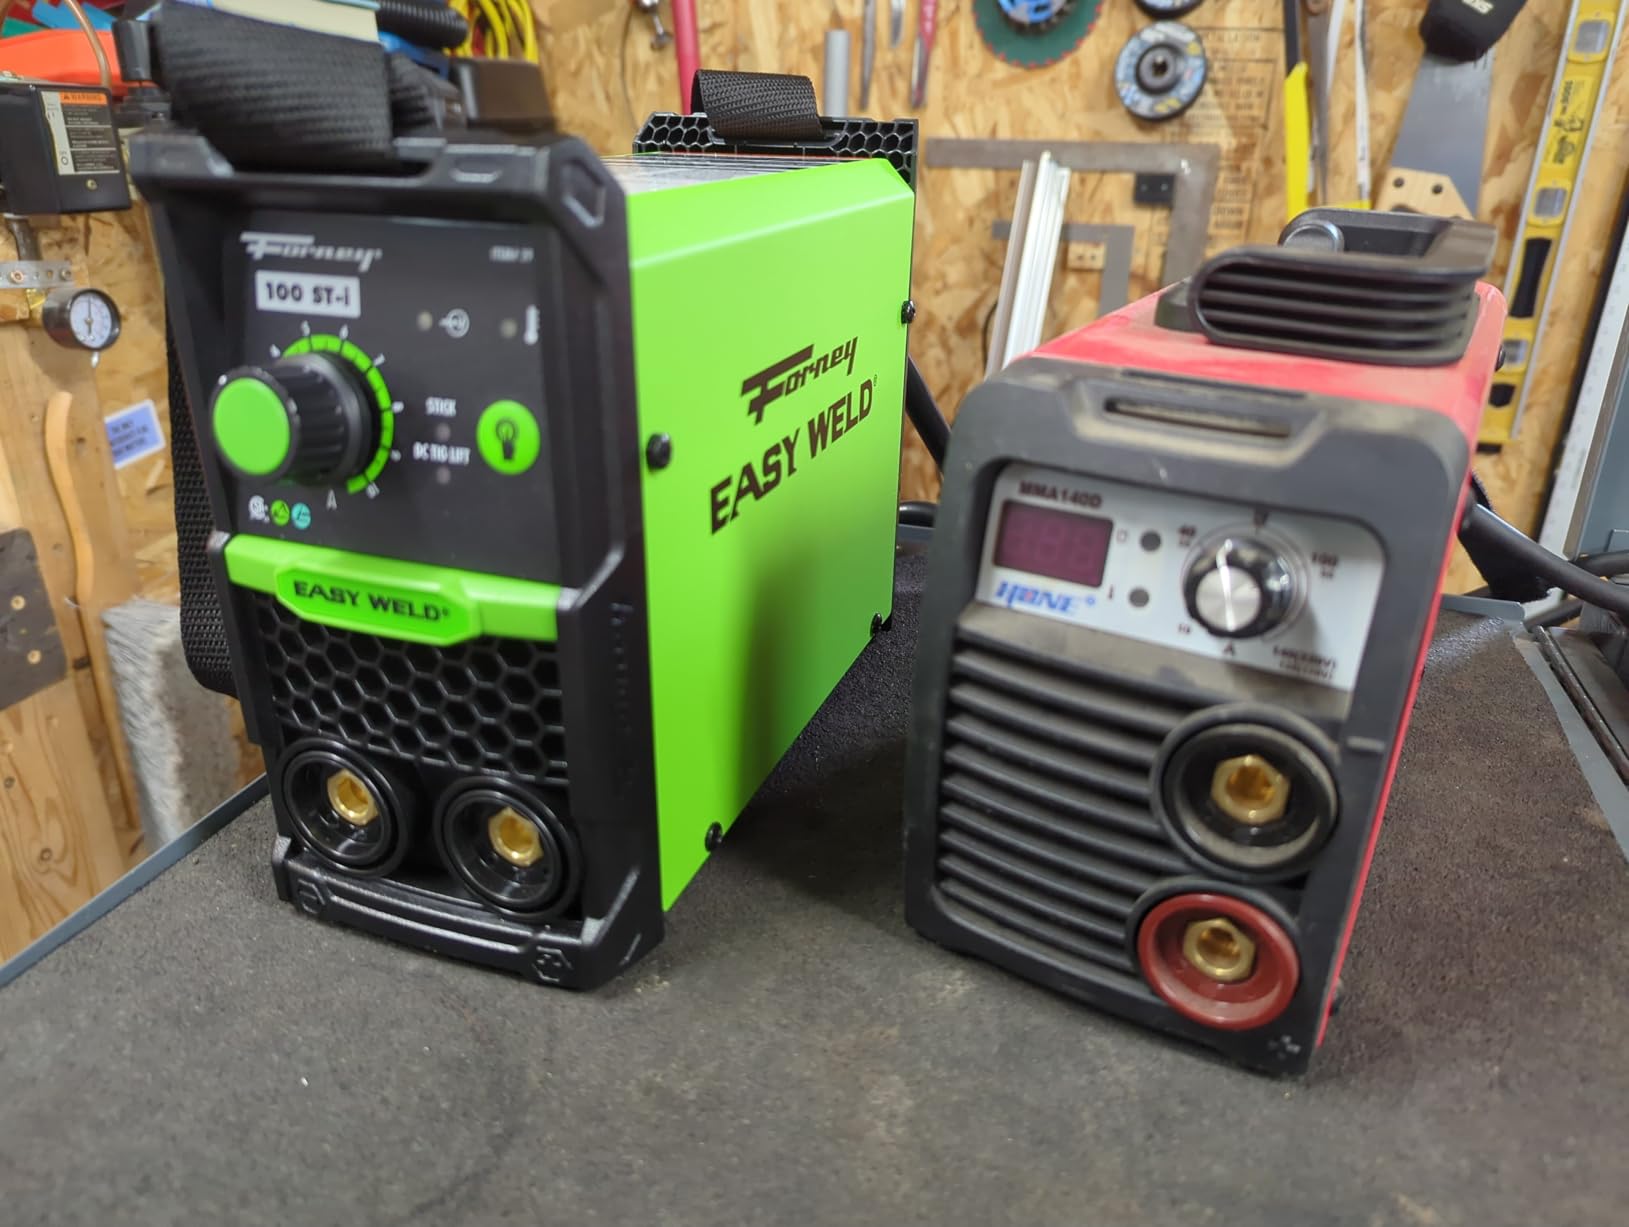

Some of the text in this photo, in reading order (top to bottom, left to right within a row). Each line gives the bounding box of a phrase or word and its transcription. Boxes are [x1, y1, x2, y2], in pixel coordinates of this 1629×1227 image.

[240, 231, 379, 272] Forney
[265, 282, 303, 301] 100
[741, 336, 858, 426] Forney
[425, 396, 457, 417] STICK
[711, 427, 800, 535] EASY
[293, 580, 361, 607] EASY
